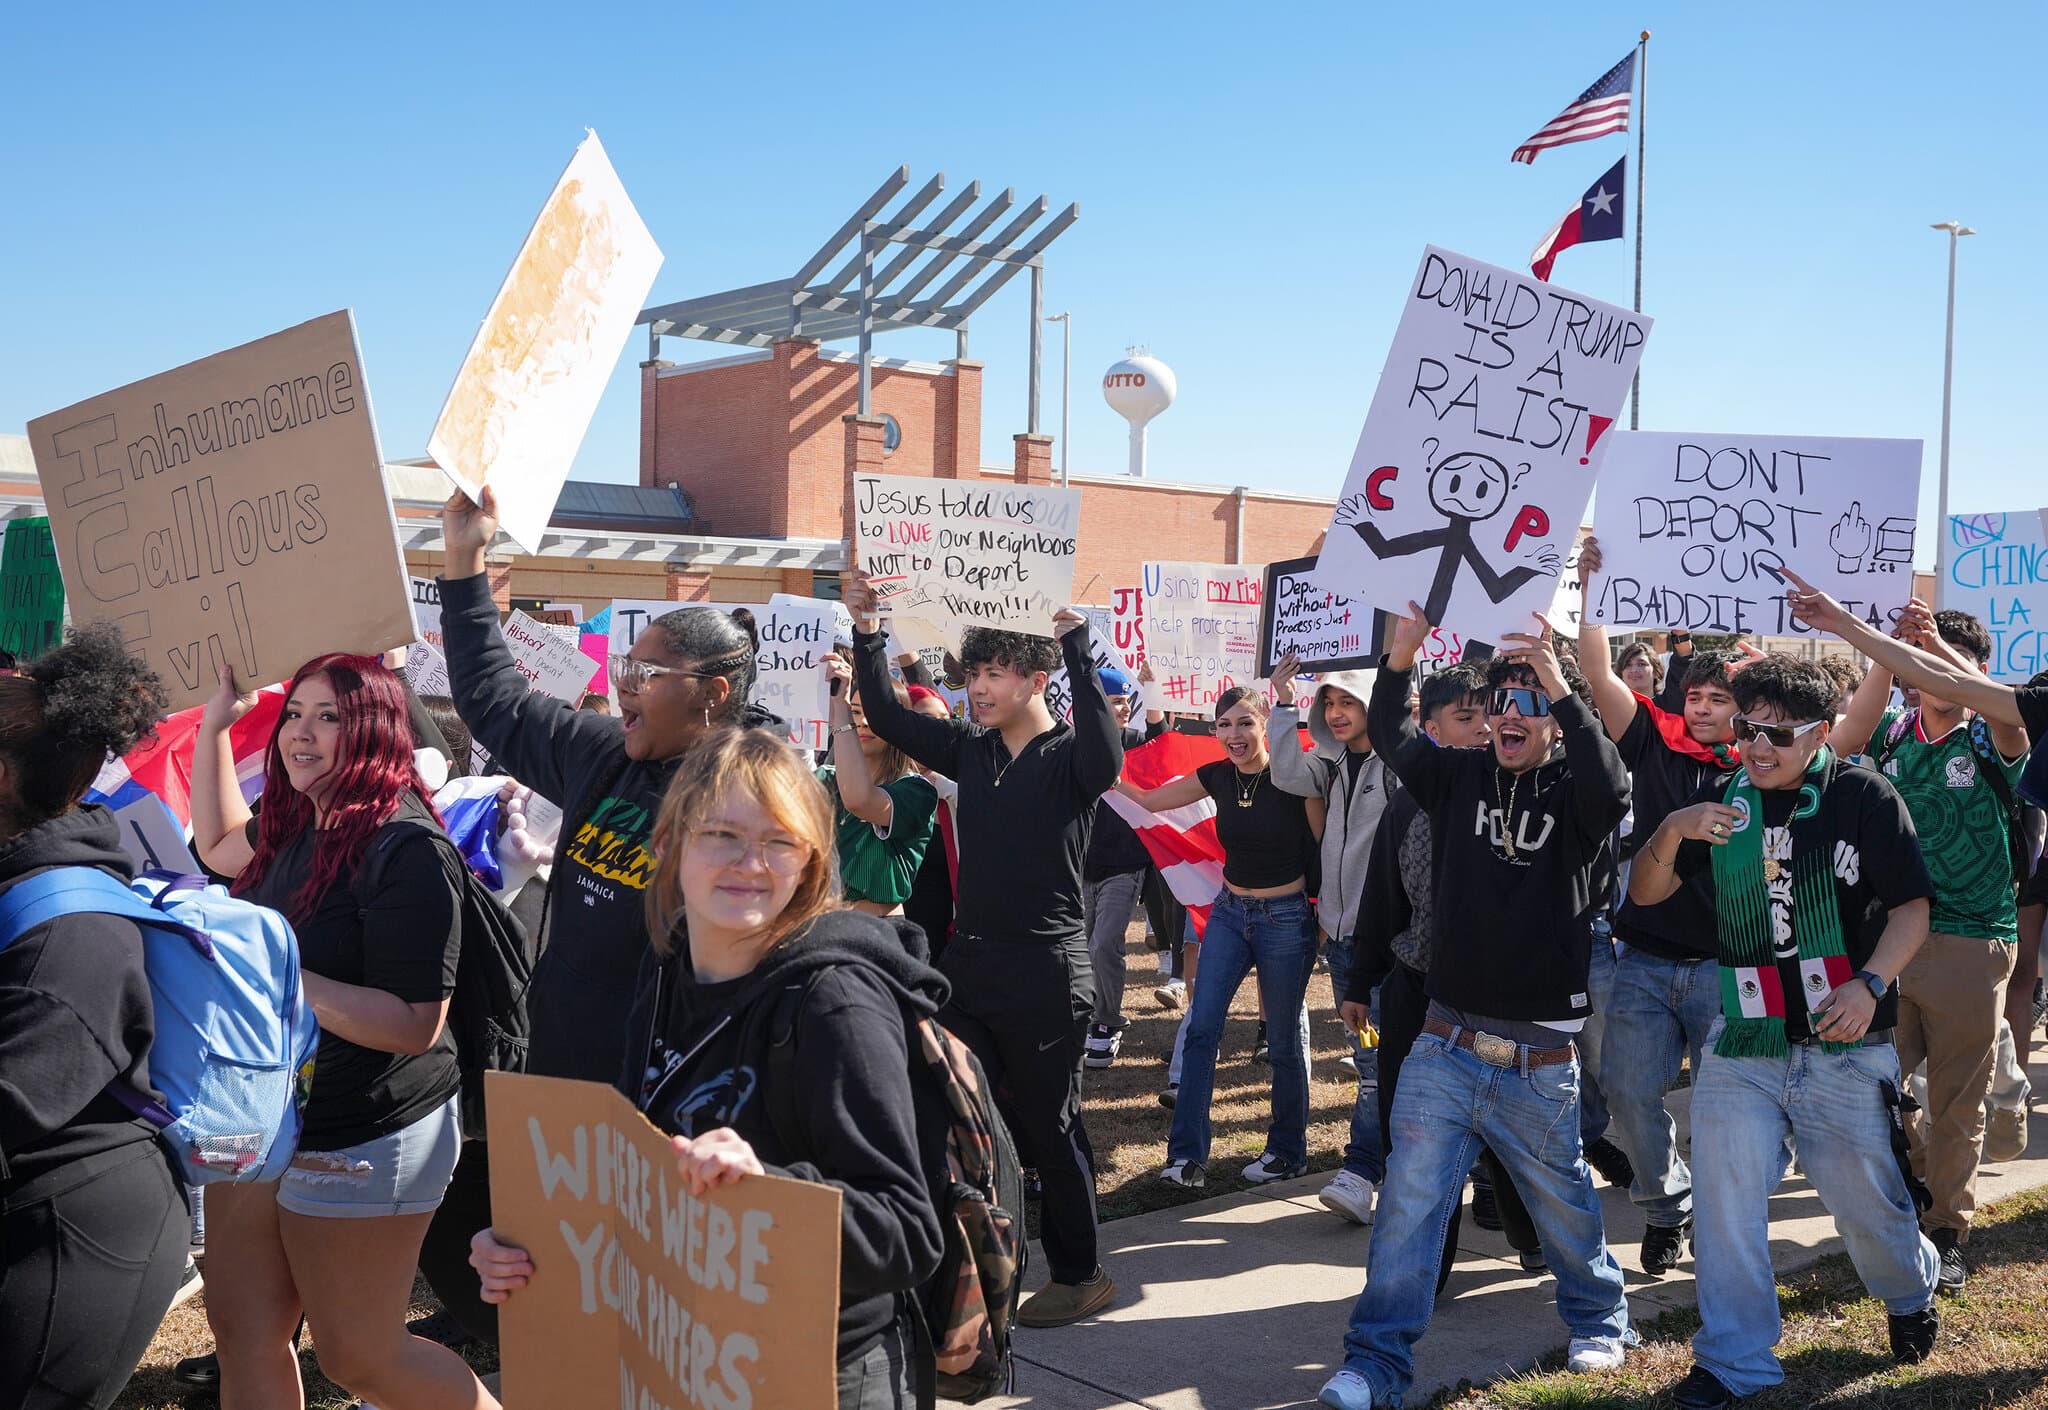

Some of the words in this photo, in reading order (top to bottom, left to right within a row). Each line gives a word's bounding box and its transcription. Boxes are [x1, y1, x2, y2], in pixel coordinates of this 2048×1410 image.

[1416, 253, 1540, 330] DONALD
[1548, 292, 1644, 364] TRUMP
[1454, 322, 1515, 370] IS
[1526, 349, 1564, 391] A
[1104, 373, 1146, 388] UTTO
[52, 362, 355, 509] Inhumane
[1365, 465, 1399, 511] C
[1674, 443, 1831, 495] DONT
[858, 478, 931, 515] Jesus
[939, 488, 991, 518] told
[1005, 499, 1033, 525] us
[1633, 495, 1822, 548] DEPORT
[76, 476, 328, 602] Callous
[861, 521, 882, 537] to
[889, 521, 933, 544] LOVE
[940, 529, 972, 549] Our
[979, 531, 1076, 564] Neighbors
[1503, 505, 1550, 553] P
[1960, 513, 1998, 544] ICE
[869, 554, 906, 576] NOT
[912, 554, 932, 571] to
[945, 556, 1029, 590] Deport
[1144, 564, 1200, 599] Using
[1207, 579, 1231, 602] my
[1681, 544, 1786, 585] OUR
[1867, 561, 1896, 573] ICE
[1279, 592, 1333, 619] Without
[1990, 597, 2031, 626] LA
[506, 623, 546, 652] History
[761, 613, 828, 643] dent
[1206, 655, 1233, 677] give
[576, 874, 615, 901] JAMAICA
[527, 1115, 650, 1243] WHERE
[659, 1164, 774, 1305] WERE
[559, 1219, 643, 1343] YOUR
